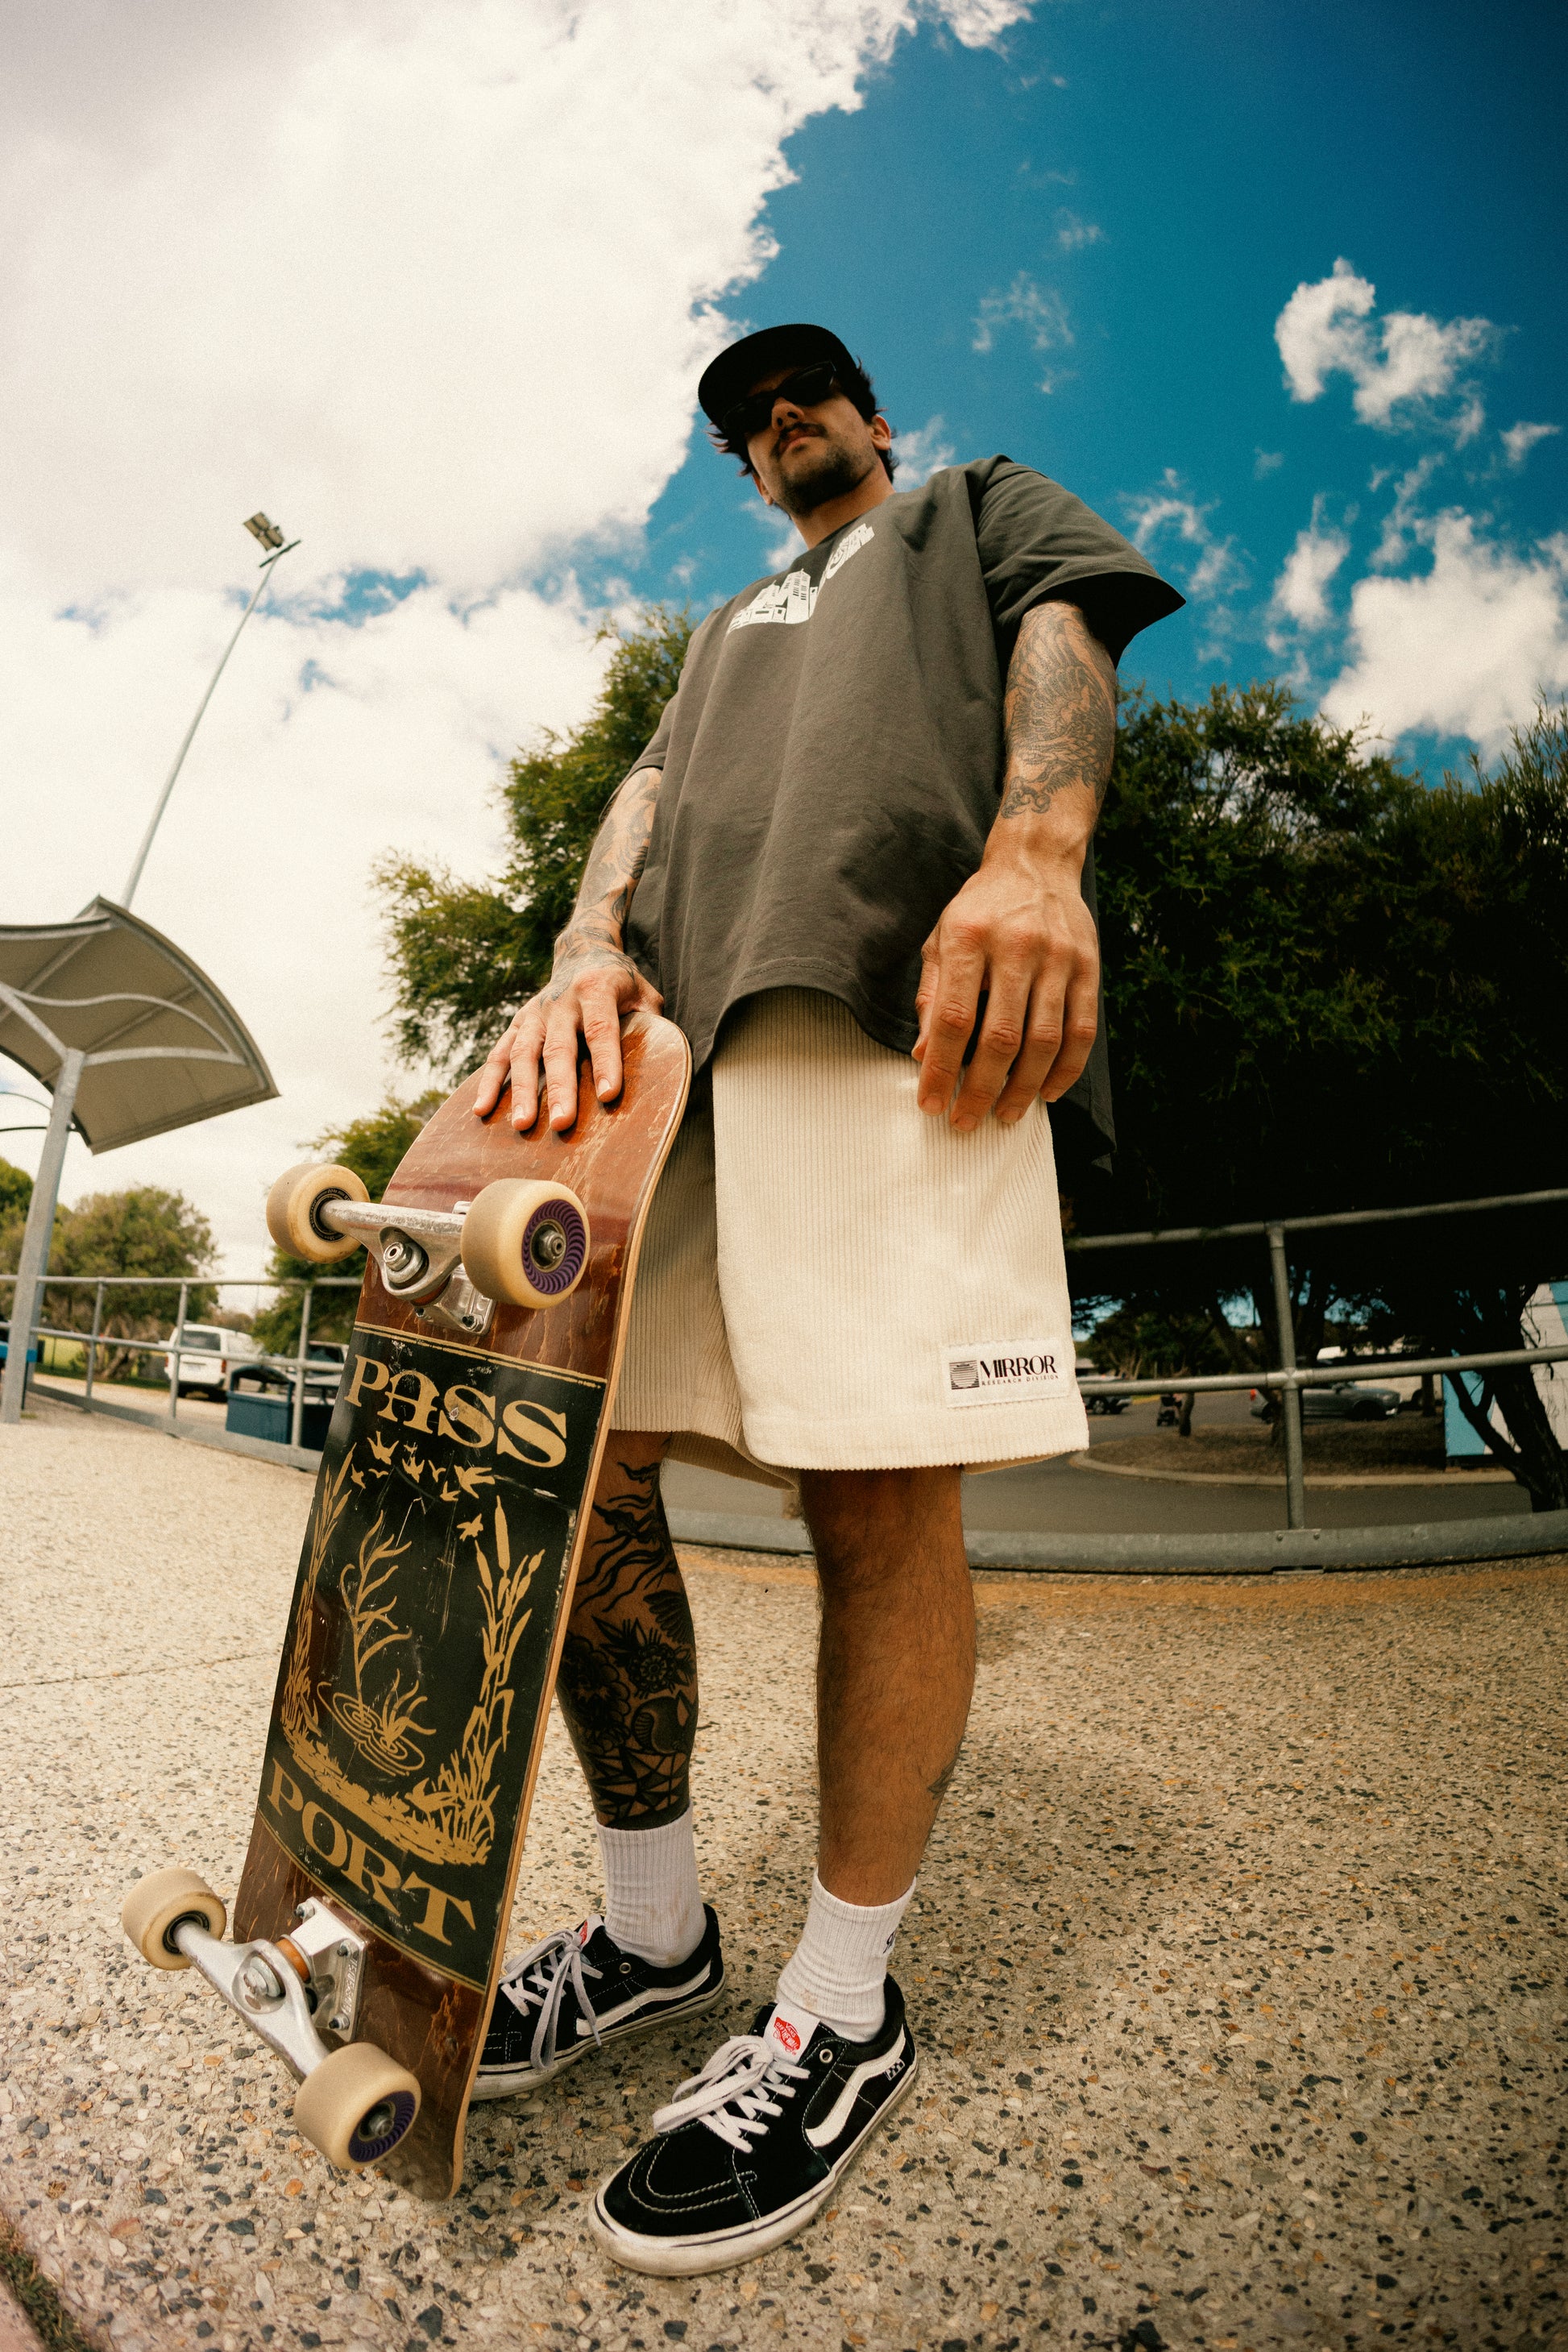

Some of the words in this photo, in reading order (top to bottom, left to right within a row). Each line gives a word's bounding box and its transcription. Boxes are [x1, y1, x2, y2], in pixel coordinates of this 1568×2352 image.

[980, 1355, 1057, 1379] MIRROR
[981, 1378, 1022, 1386] RESEARCH
[343, 1354, 567, 1468] PASS
[267, 1757, 476, 1947] PORT
[786, 2022, 796, 2038] VANS
